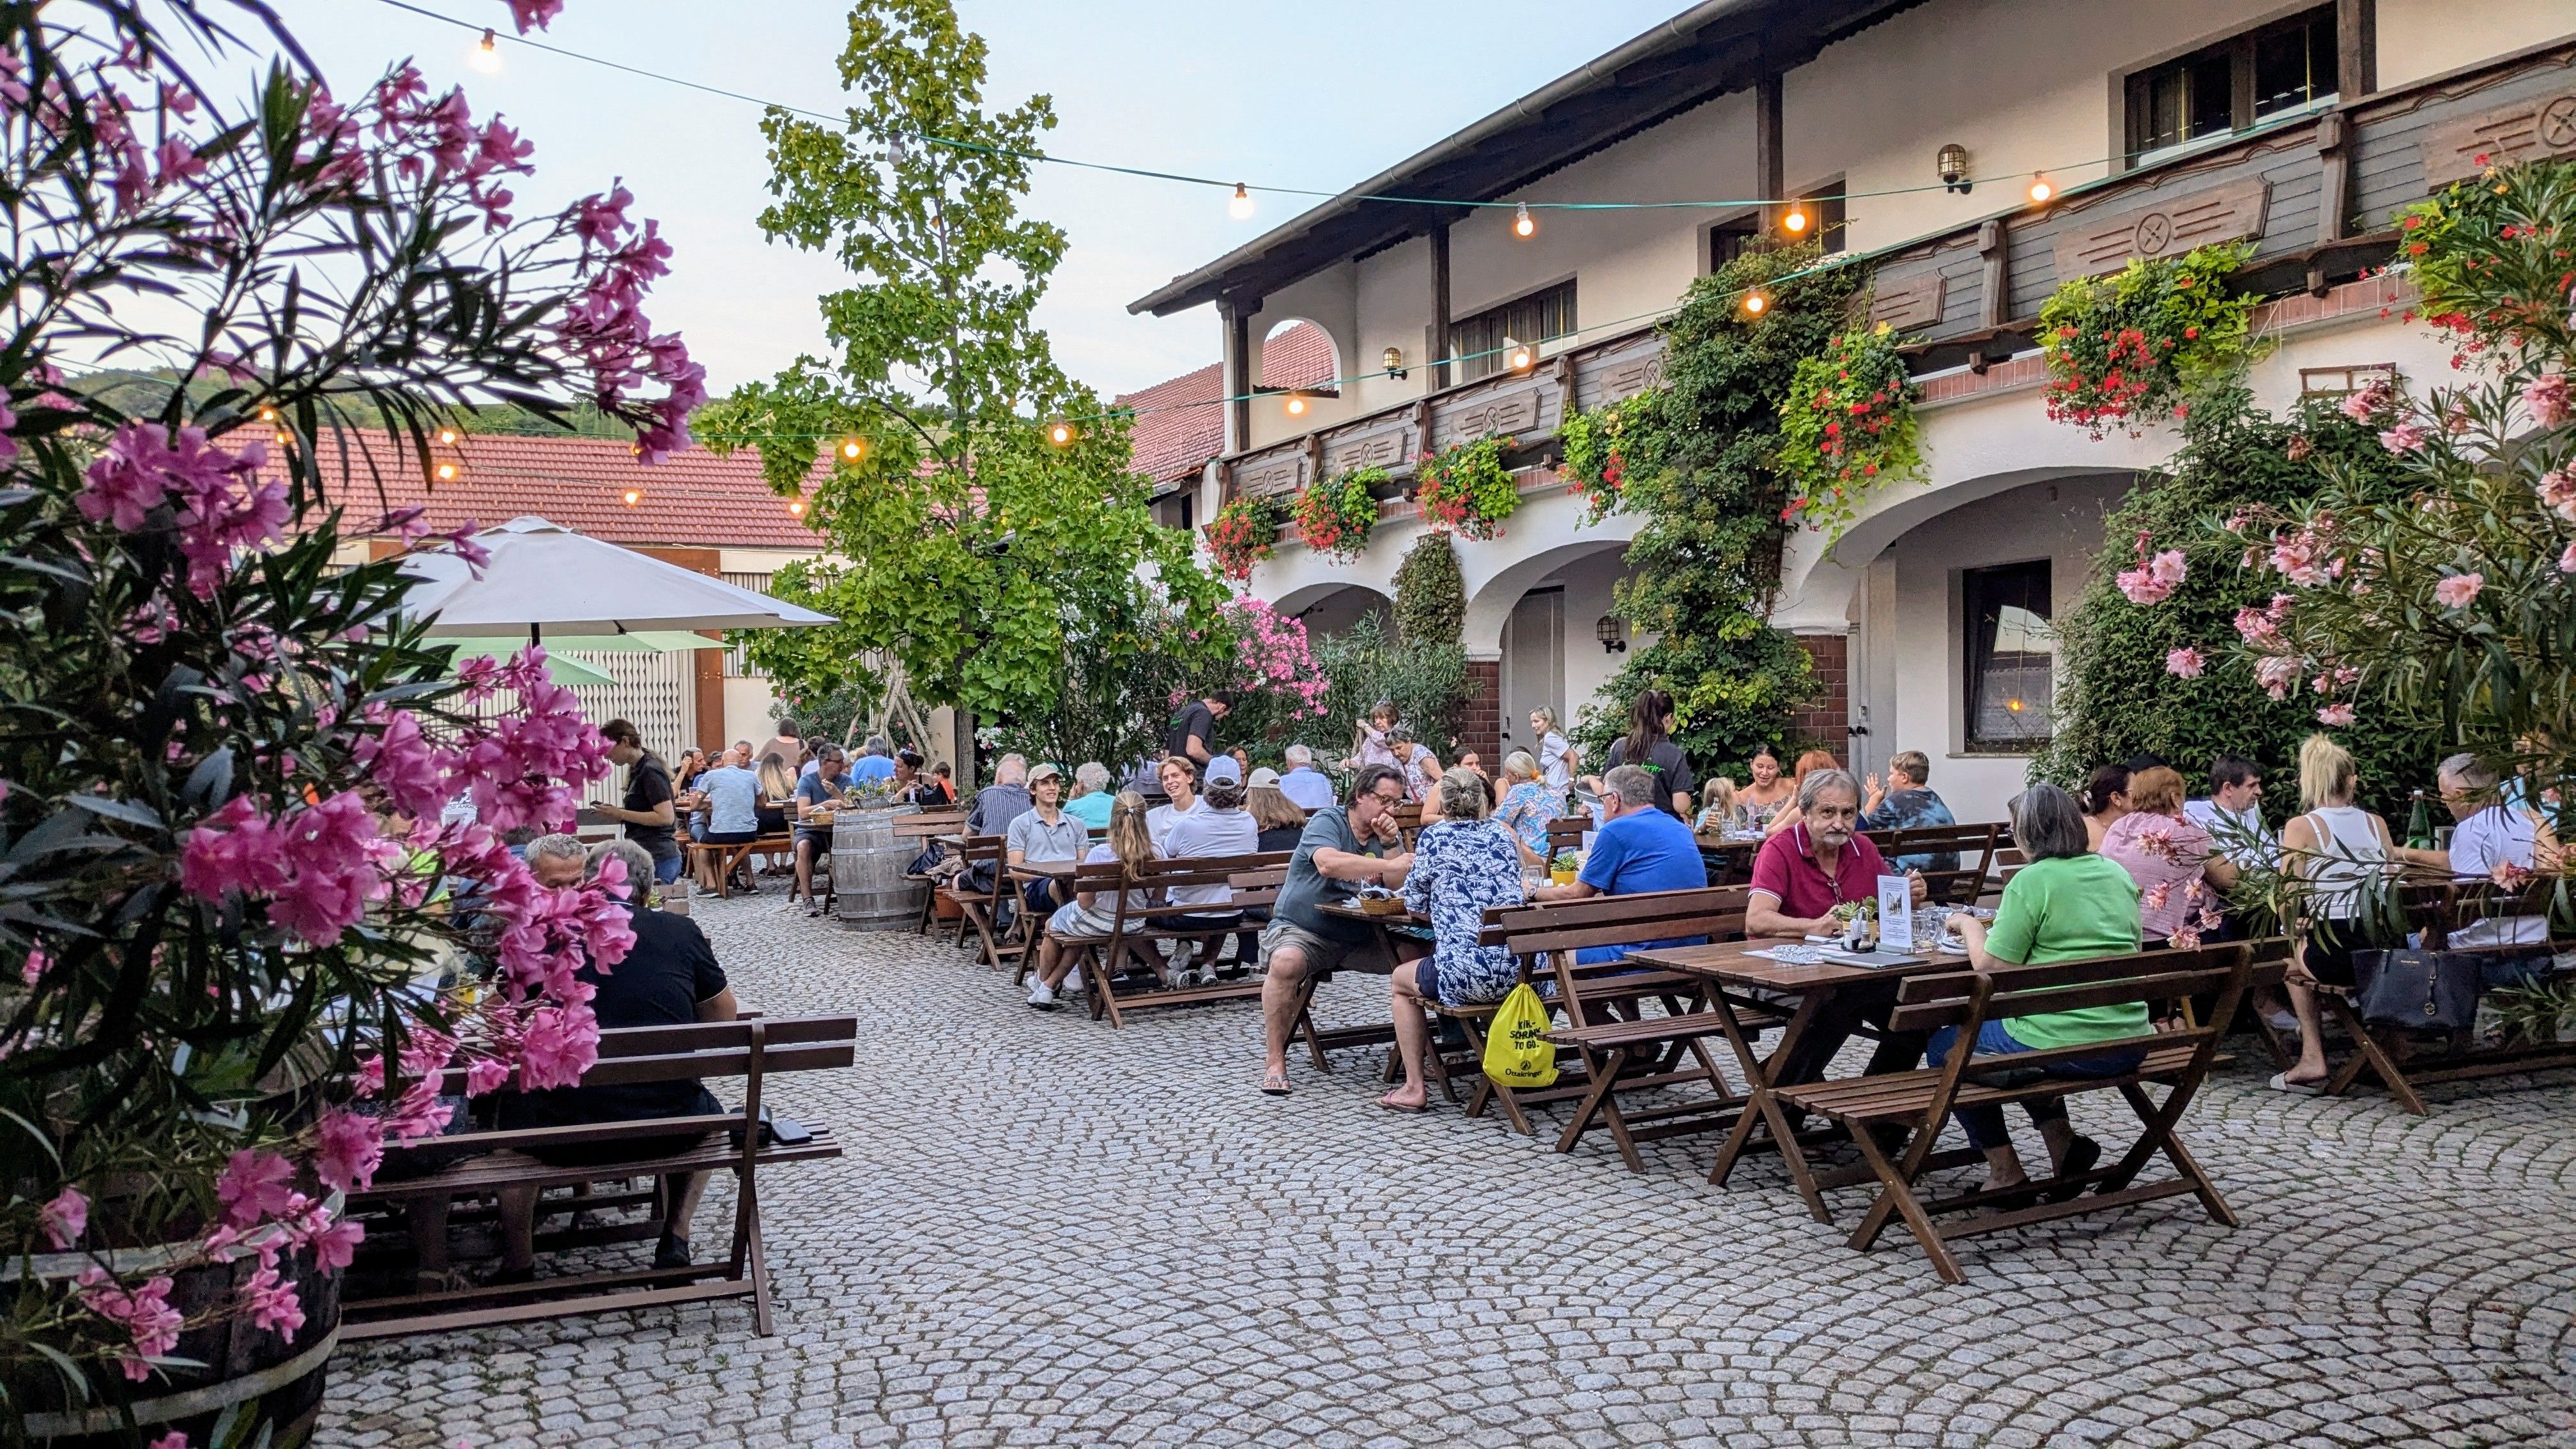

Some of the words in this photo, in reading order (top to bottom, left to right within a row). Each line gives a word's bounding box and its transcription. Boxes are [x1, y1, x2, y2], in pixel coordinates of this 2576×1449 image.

[1515, 1041, 1524, 1050] TO
[1526, 1039, 1540, 1049] GO.
[1505, 1068, 1543, 1078] Ottakringer
